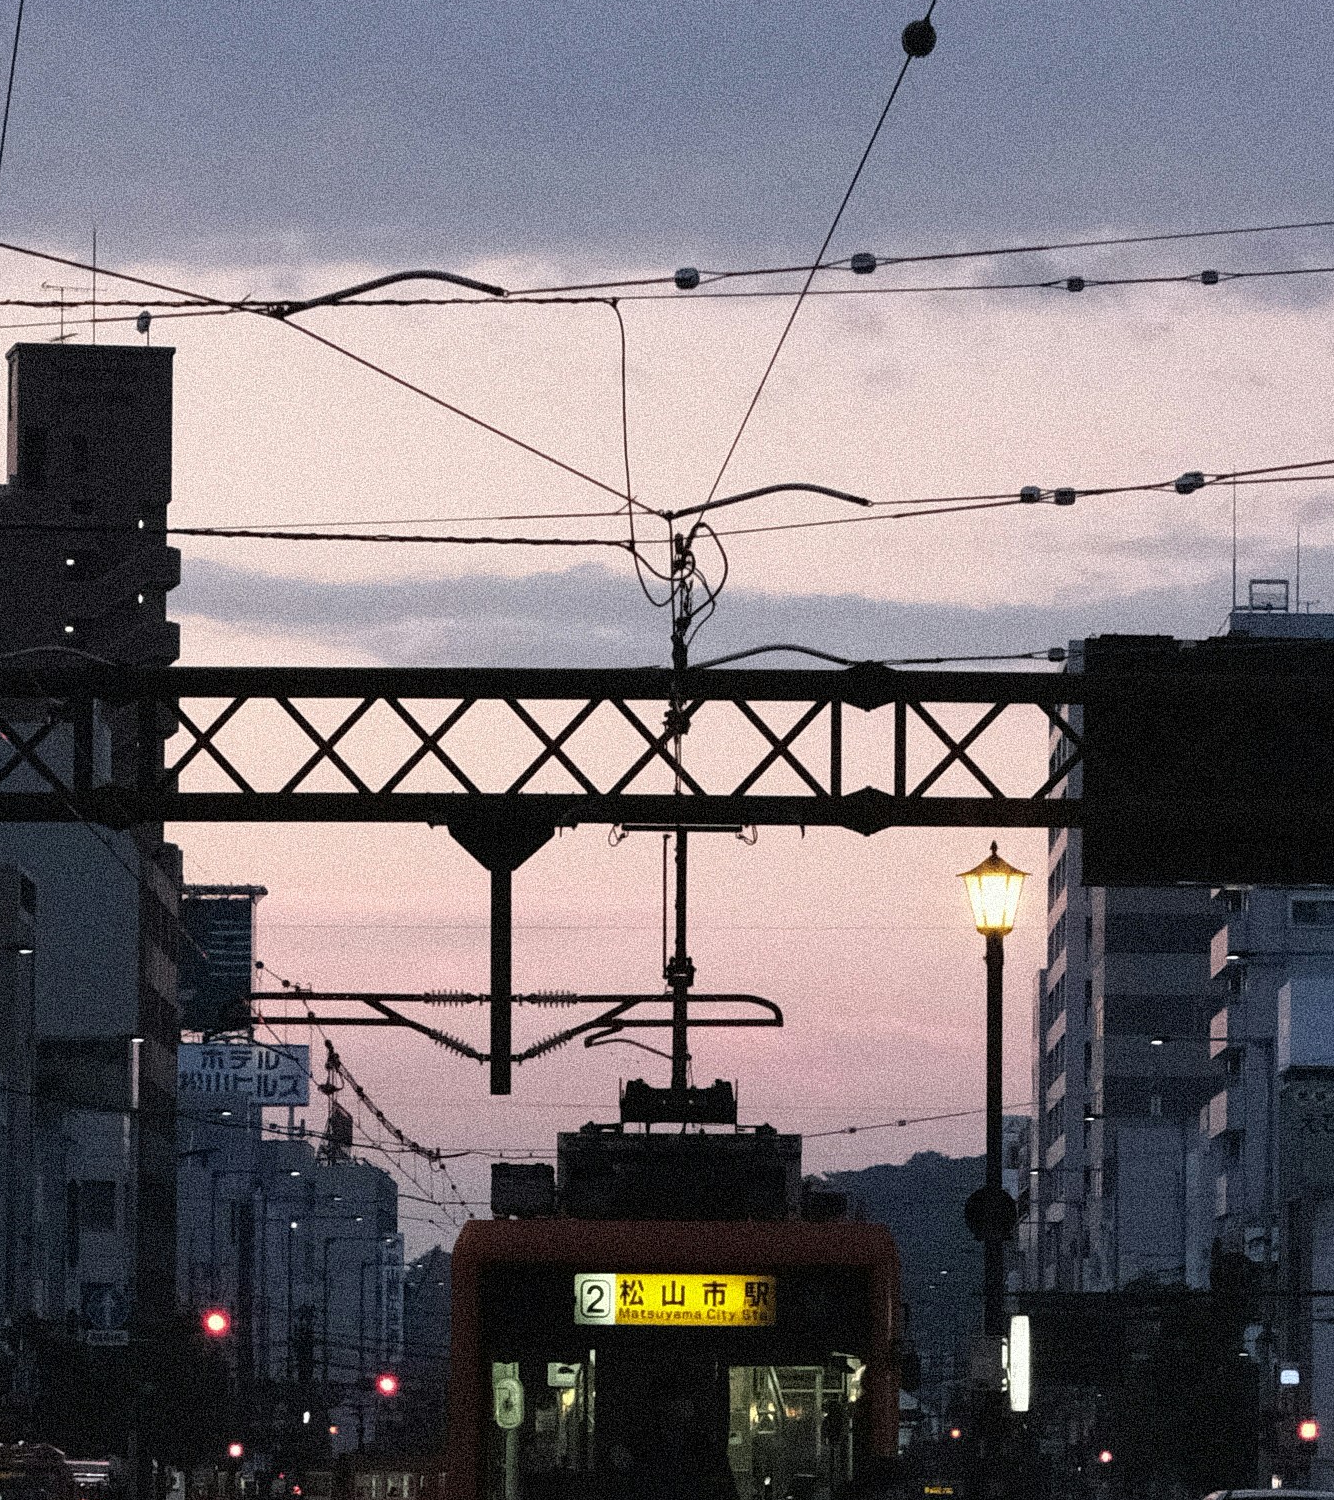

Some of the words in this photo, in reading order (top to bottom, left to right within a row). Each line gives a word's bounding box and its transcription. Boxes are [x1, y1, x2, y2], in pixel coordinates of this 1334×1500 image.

[201, 1050, 280, 1070] ホテル
[586, 1285, 605, 1313] 2
[619, 1280, 769, 1307] 松山市駅
[618, 1308, 702, 1322] Matsuyama
[706, 1308, 734, 1322] City
